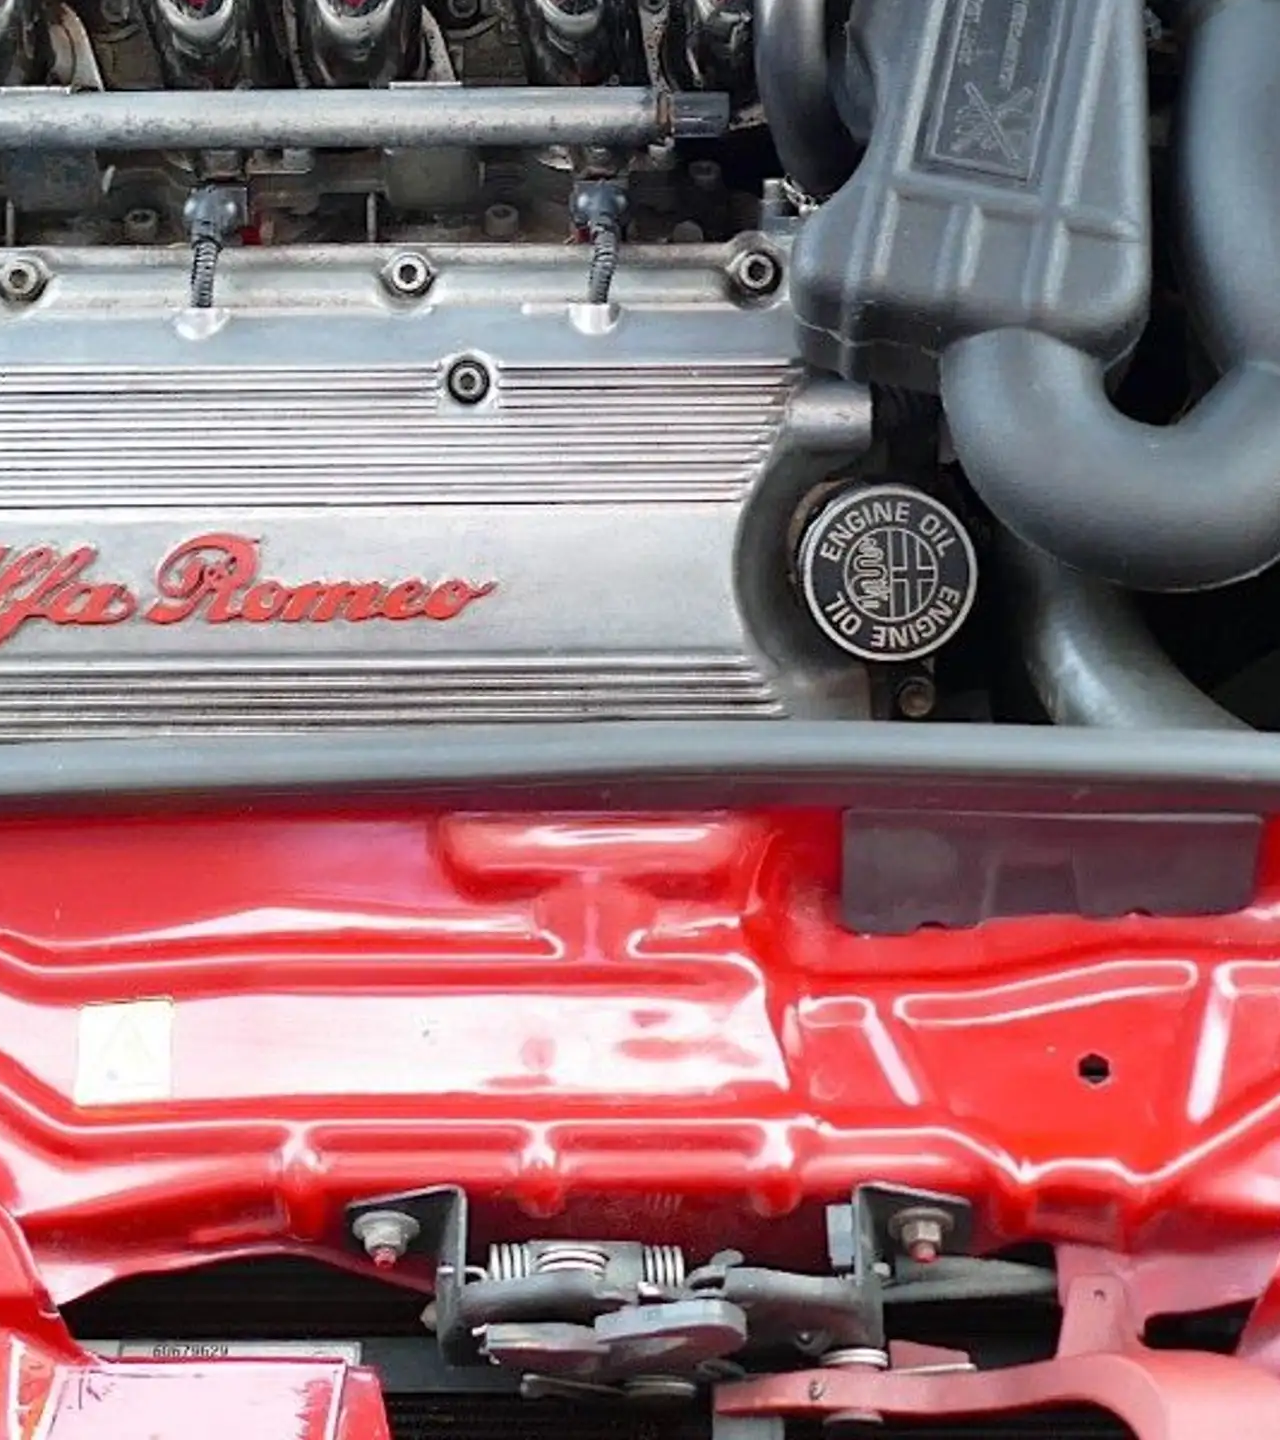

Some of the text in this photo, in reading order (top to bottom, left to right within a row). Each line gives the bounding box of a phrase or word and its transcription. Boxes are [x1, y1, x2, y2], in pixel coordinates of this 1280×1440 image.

[819, 500, 957, 563] ENGINE OIL
[142, 531, 498, 624] Romeo
[825, 585, 961, 649] ENGINE OIL
